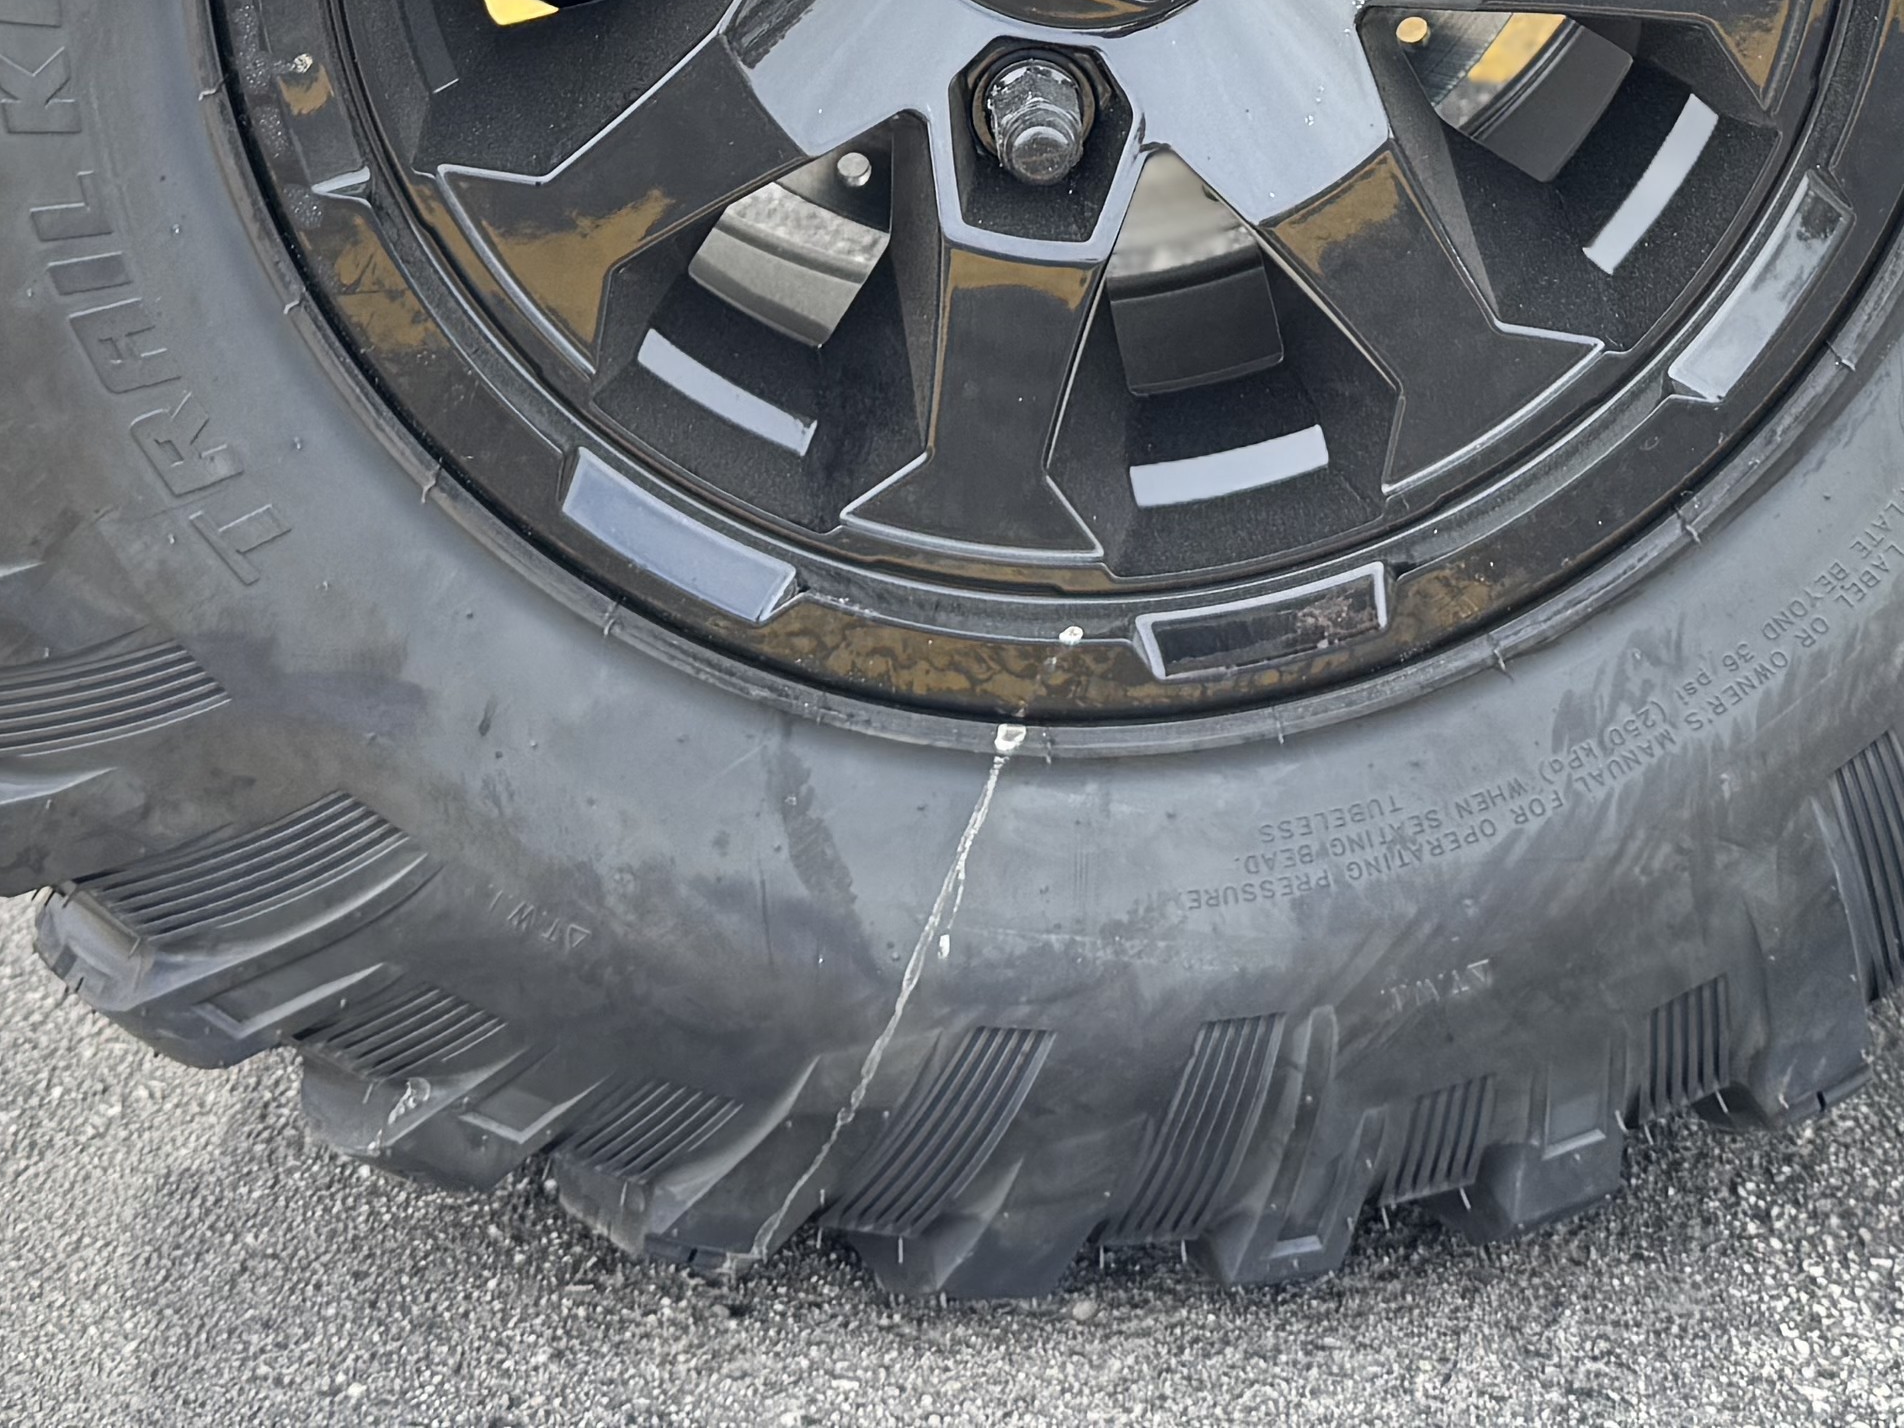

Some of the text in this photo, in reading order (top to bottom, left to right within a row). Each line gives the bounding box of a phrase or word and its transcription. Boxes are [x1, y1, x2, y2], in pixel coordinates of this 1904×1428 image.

[29, 170, 292, 586] TRAIL
[1760, 561, 1848, 641] BEYOND
[1793, 616, 1830, 648] OR
[1721, 642, 1755, 672] 36
[1674, 667, 1713, 706] psi
[1683, 650, 1789, 731] OWNER'S
[1573, 728, 1677, 793] MANUAL
[1258, 794, 1404, 843] TUBELESS
[1454, 777, 1528, 819] WHEN
[1509, 789, 1564, 826] FOR
[1329, 808, 1444, 857] SEATING
[1345, 818, 1498, 881] OPERATING
[1233, 843, 1315, 875] BEAD.
